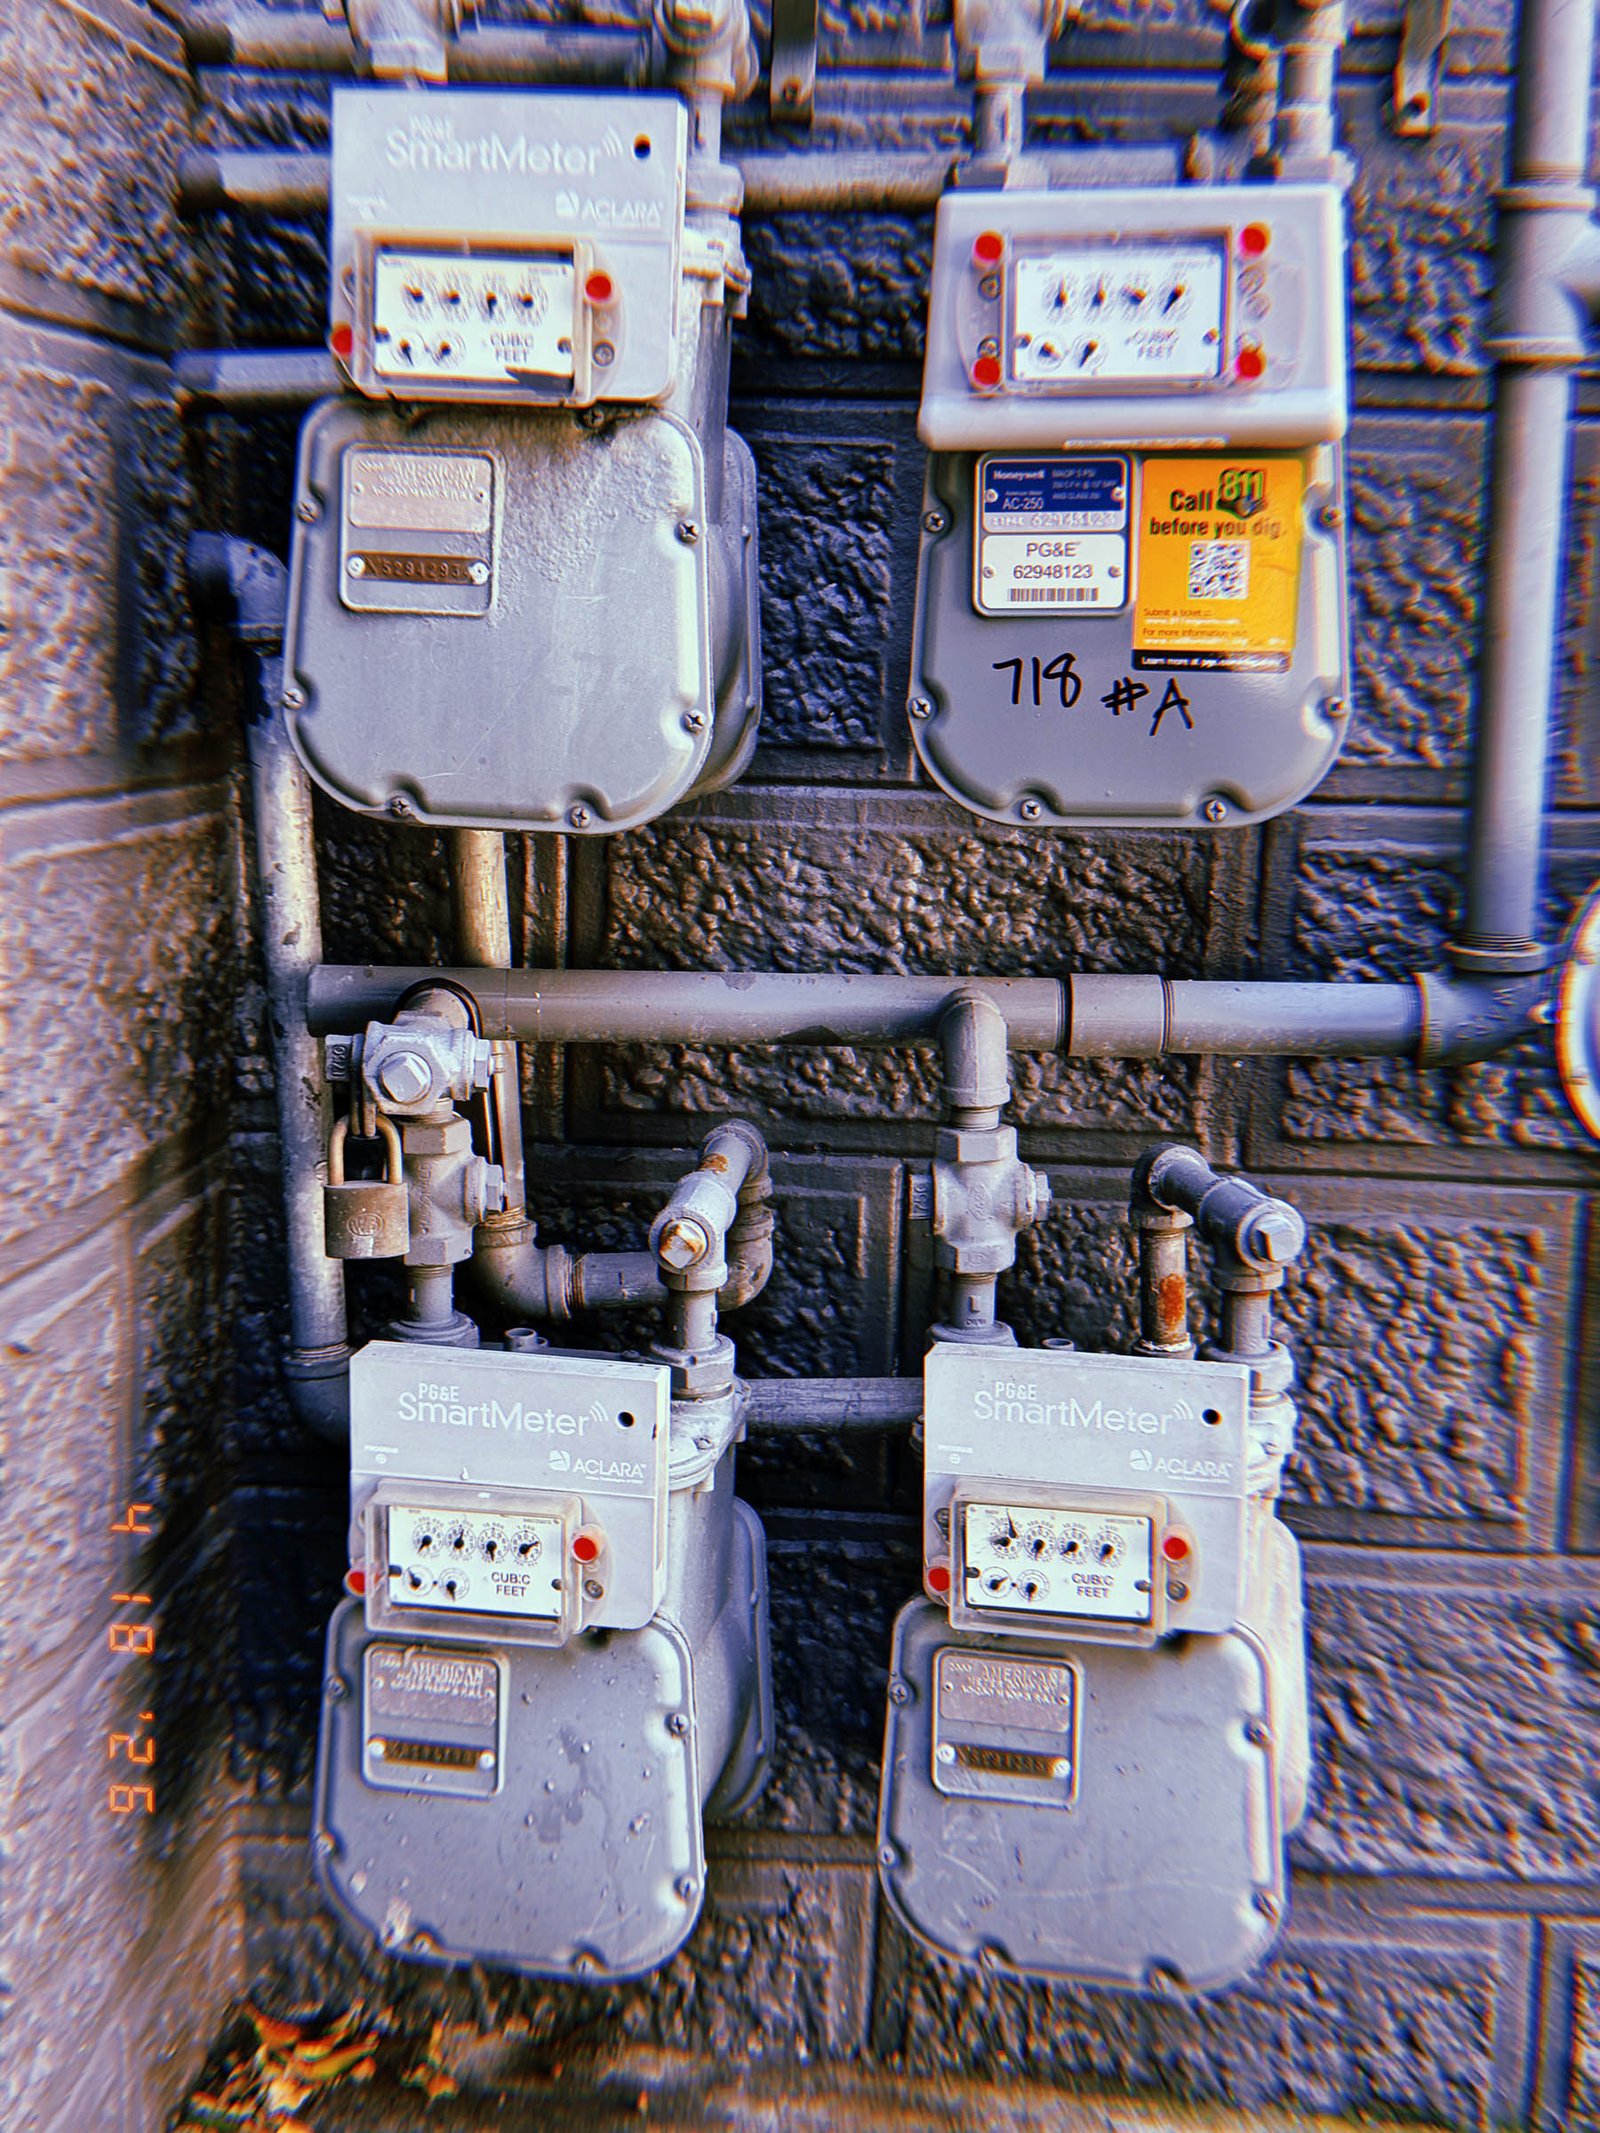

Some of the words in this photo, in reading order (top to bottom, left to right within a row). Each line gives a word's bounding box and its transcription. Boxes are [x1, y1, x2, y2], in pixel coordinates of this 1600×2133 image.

[386, 127, 598, 176] SmartMeter
[581, 197, 661, 224] ACLARA
[993, 470, 1046, 481] Honeywell
[1170, 488, 1213, 512] Call
[1219, 468, 1267, 501] 811
[1002, 497, 1045, 510] AC-250
[1150, 517, 1209, 536] before
[1215, 520, 1247, 540] you
[1026, 542, 1076, 557] PG&E
[1013, 565, 1093, 579] 62948123
[1143, 628, 1155, 636] For
[993, 653, 1082, 708] 718
[418, 1383, 460, 1402] PG&E
[995, 1382, 1037, 1400] PG&E
[398, 1392, 590, 1436] SmartMeter
[974, 1391, 1173, 1434] SmartMeter
[573, 1458, 643, 1478] ACLARA
[1154, 1458, 1231, 1479] ACLARA
[496, 1585, 527, 1597] FEET
[1076, 1586, 1111, 1598] FEET
